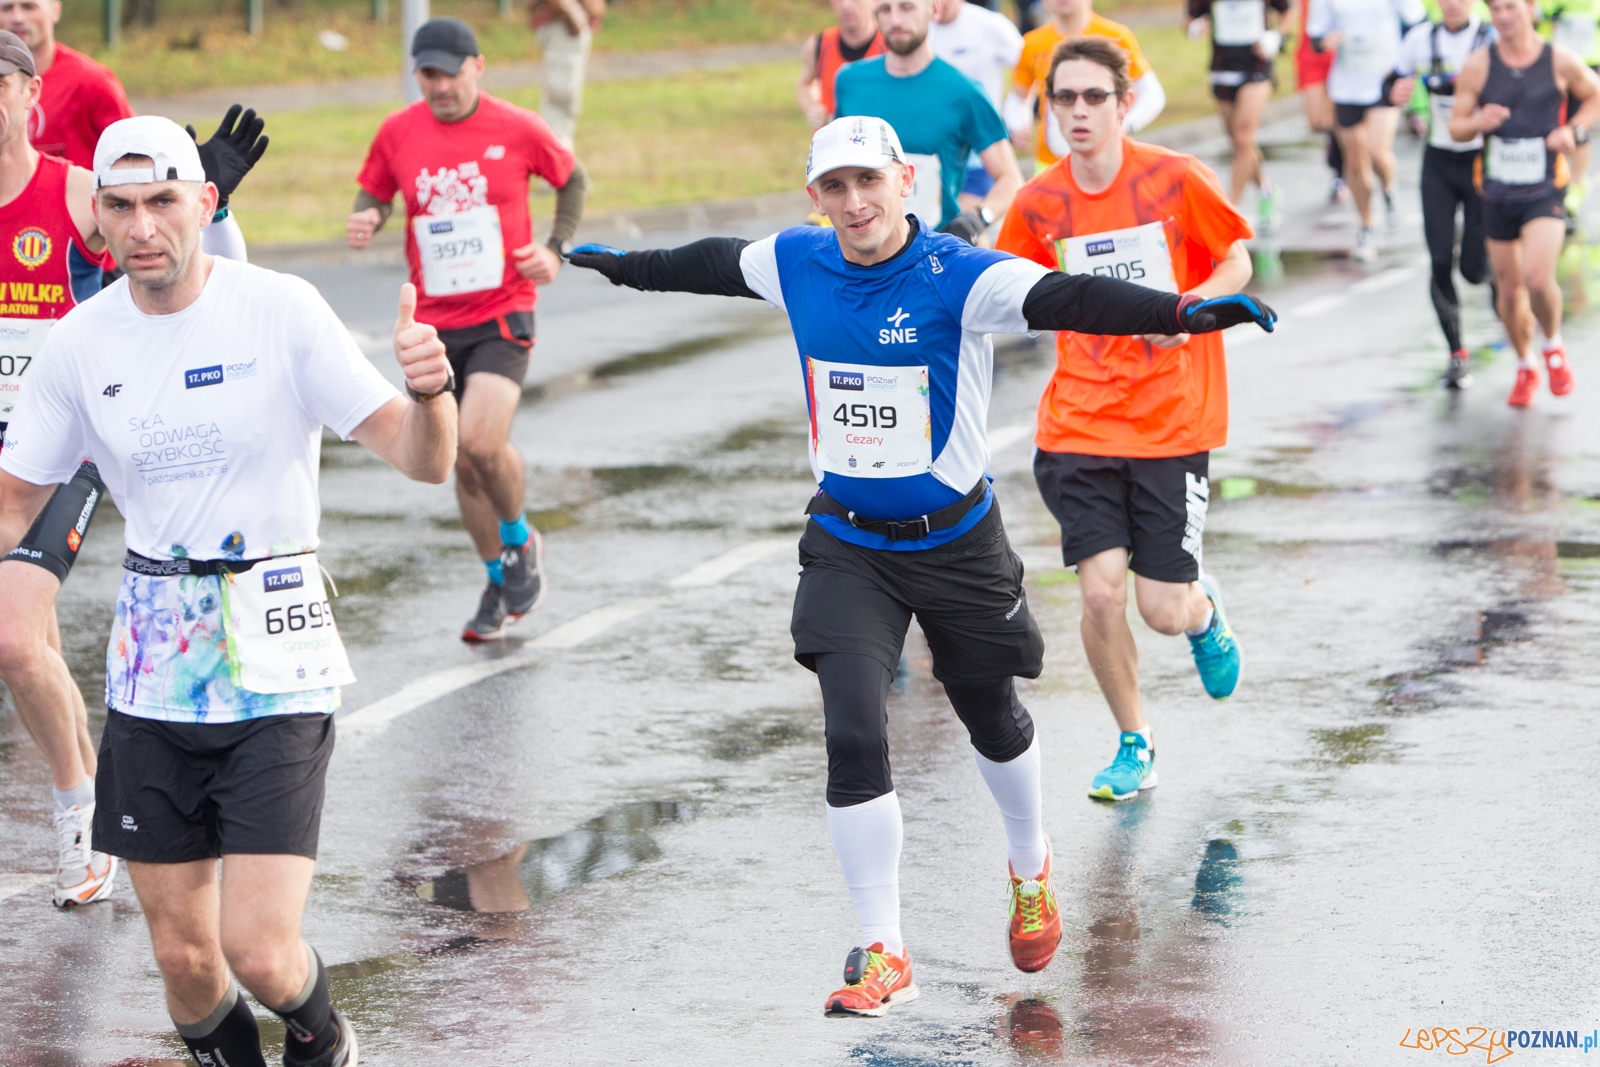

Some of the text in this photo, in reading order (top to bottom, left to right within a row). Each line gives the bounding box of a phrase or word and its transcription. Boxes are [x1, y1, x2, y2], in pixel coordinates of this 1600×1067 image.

[431, 237, 483, 260] 3979
[9, 282, 65, 303] WLKP.
[878, 327, 918, 344] SNE
[102, 384, 123, 397] 4F
[128, 413, 165, 432] SIŁA
[832, 403, 898, 429] 4519
[139, 422, 222, 448] ODWAGA
[845, 433, 884, 446] Cezary
